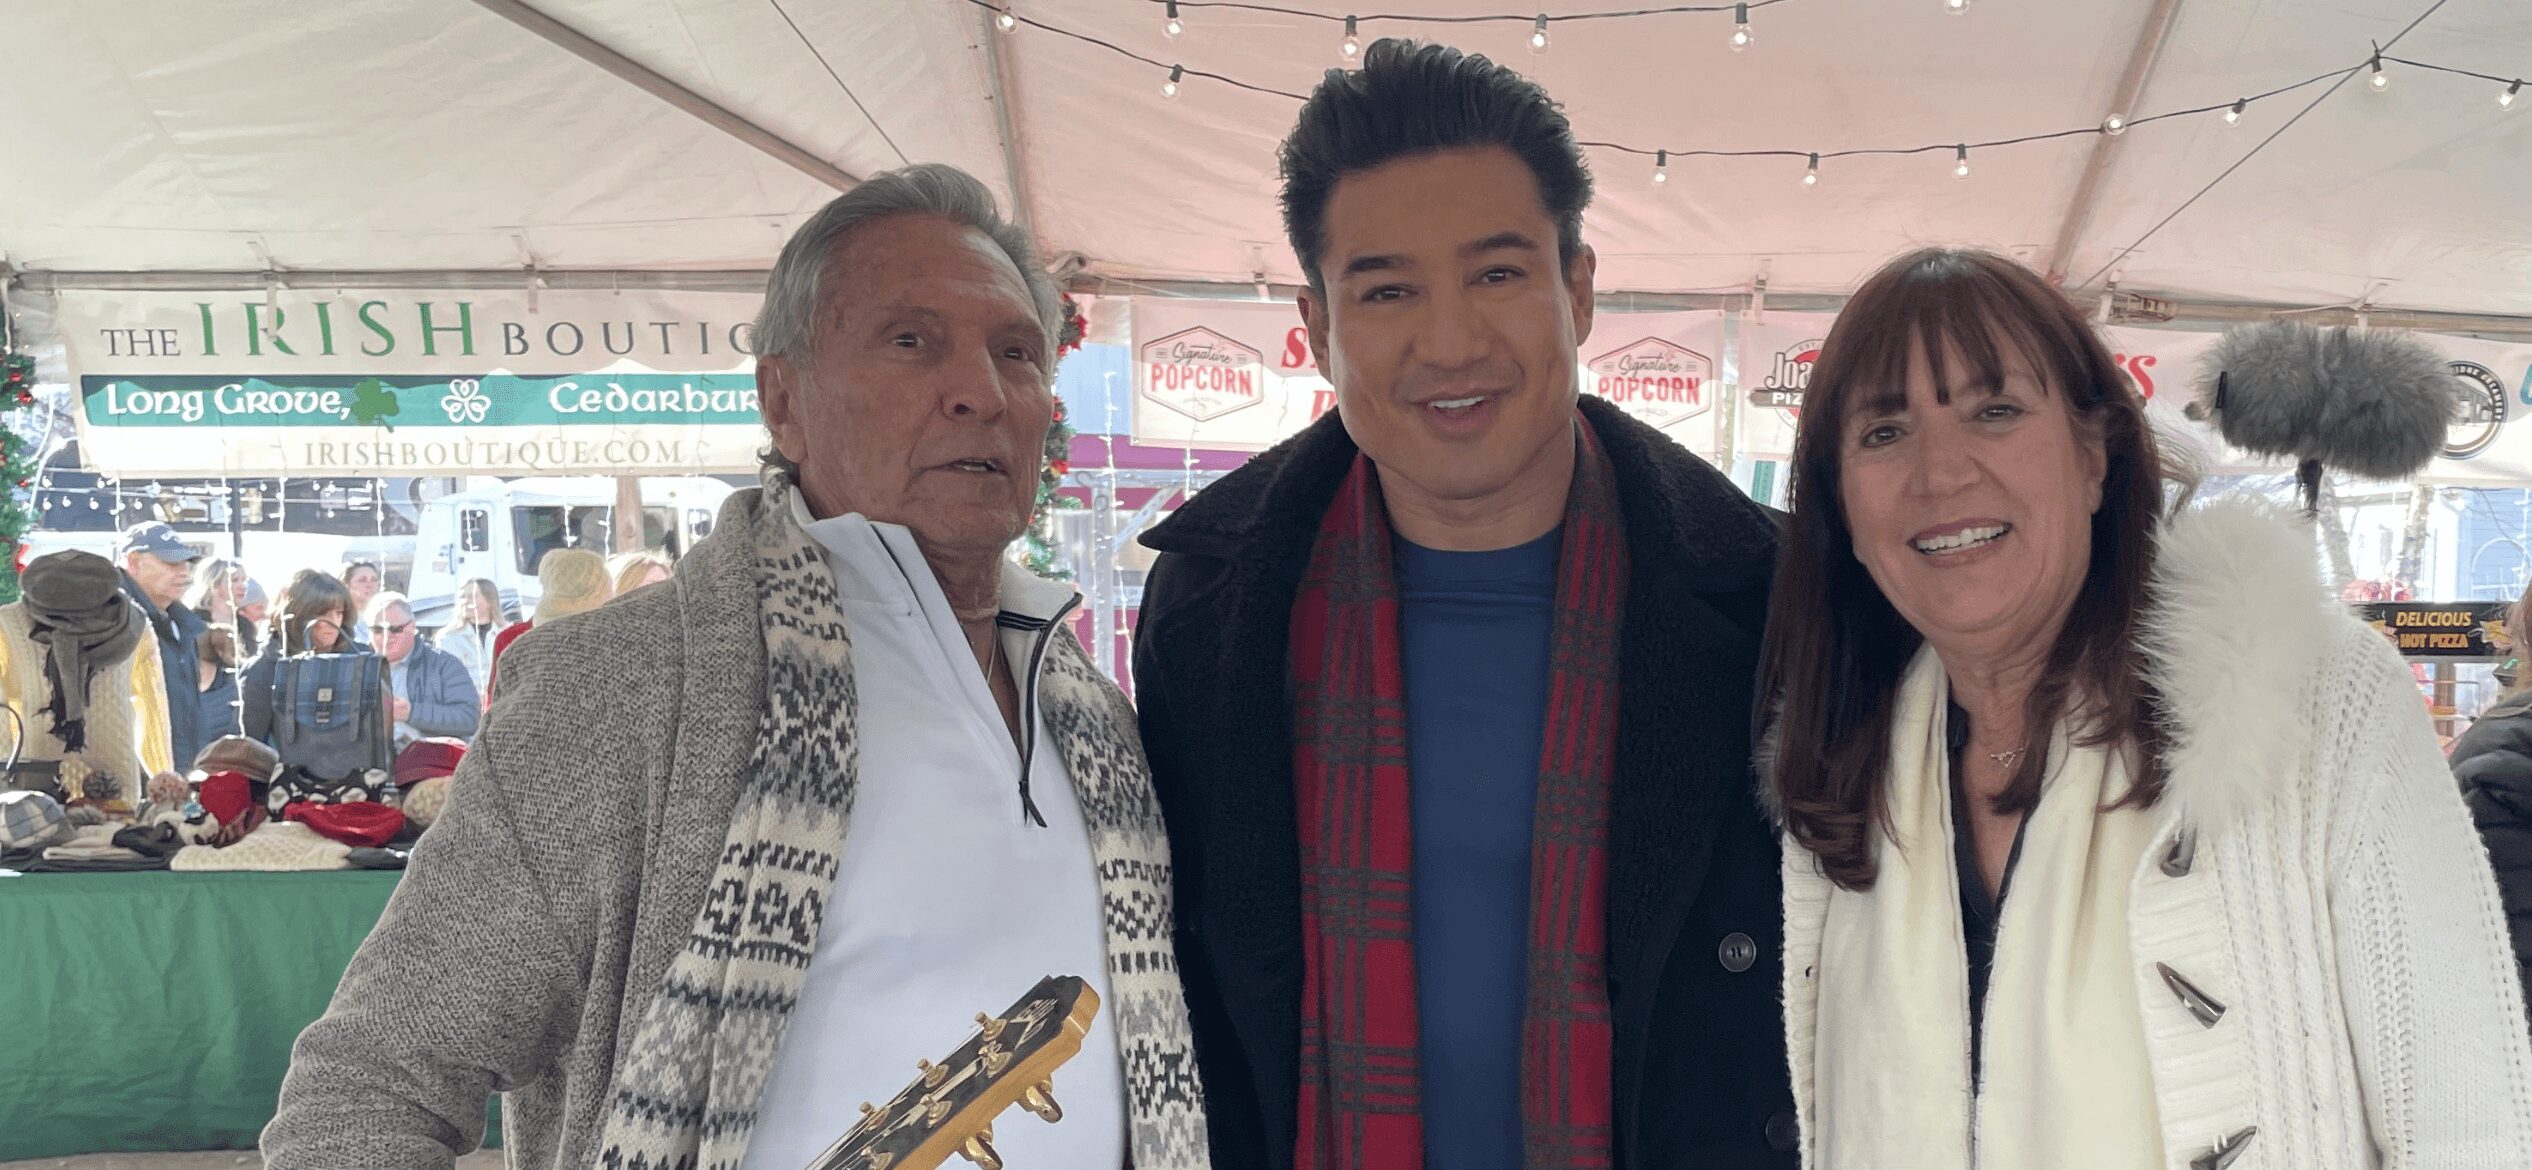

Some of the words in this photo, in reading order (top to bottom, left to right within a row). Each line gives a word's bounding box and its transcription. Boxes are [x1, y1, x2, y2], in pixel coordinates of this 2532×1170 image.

[100, 328, 181, 356] THE
[194, 300, 477, 356] IRISH
[1170, 341, 1234, 369] Signature
[1618, 352, 1681, 378] Signature
[1151, 363, 1253, 397] POPCORN
[1598, 376, 1700, 406] POPCORN
[304, 440, 683, 471] IRISHBOUTIQUE.COM
[2395, 611, 2472, 626] DELICIOUS
[2400, 633, 2427, 648] HOT
[2429, 633, 2469, 648] PIZZA
